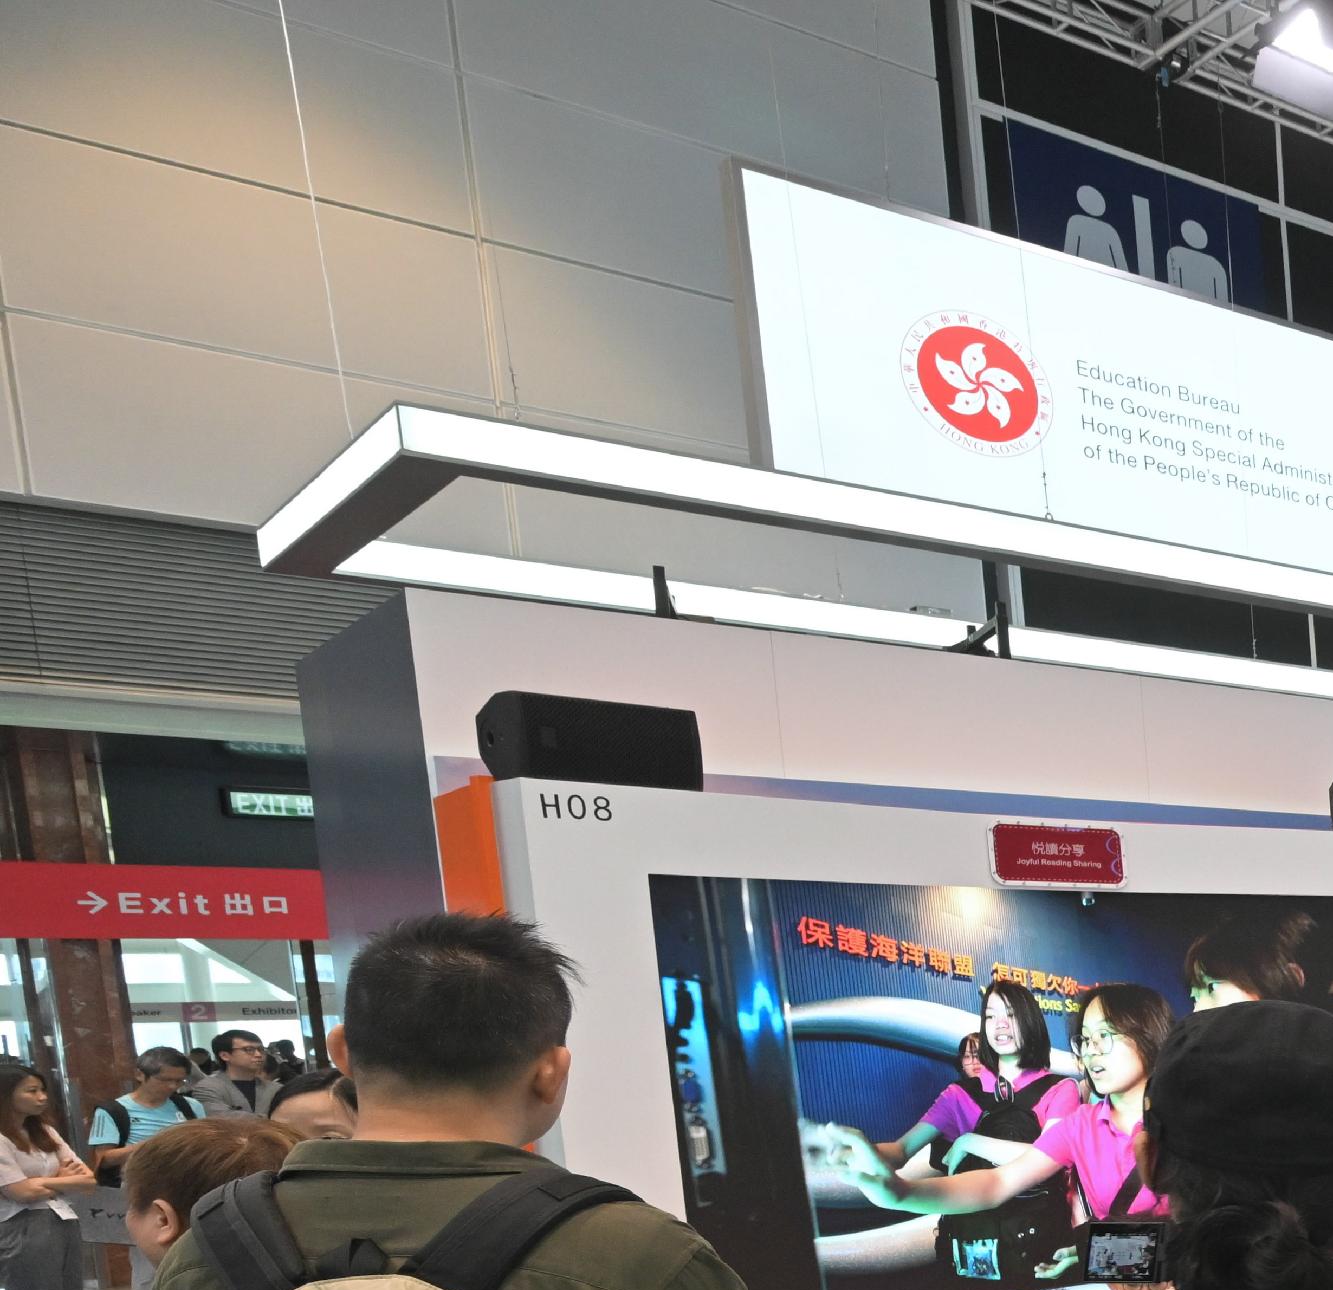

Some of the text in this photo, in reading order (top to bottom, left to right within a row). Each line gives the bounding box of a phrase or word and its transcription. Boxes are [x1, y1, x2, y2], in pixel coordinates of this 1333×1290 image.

[1076, 359, 1240, 414] Education Bureau
[1077, 386, 1285, 450] The Government of the
[1081, 414, 1132, 444] Hong
[1139, 428, 1186, 456] Kong
[1192, 440, 1255, 468] Special
[1084, 445, 1102, 460] of
[1109, 448, 1137, 468] the
[1144, 455, 1221, 485] People's
[1226, 473, 1300, 503] Republic
[1306, 493, 1320, 507] of
[237, 794, 288, 815] EXIT
[540, 793, 612, 822] H08
[1016, 857, 1102, 869] Joyful Reading Sharing
[118, 891, 289, 915] Exit 出口
[797, 915, 976, 978] 保護海洋聯盟
[189, 1003, 208, 1020] 2
